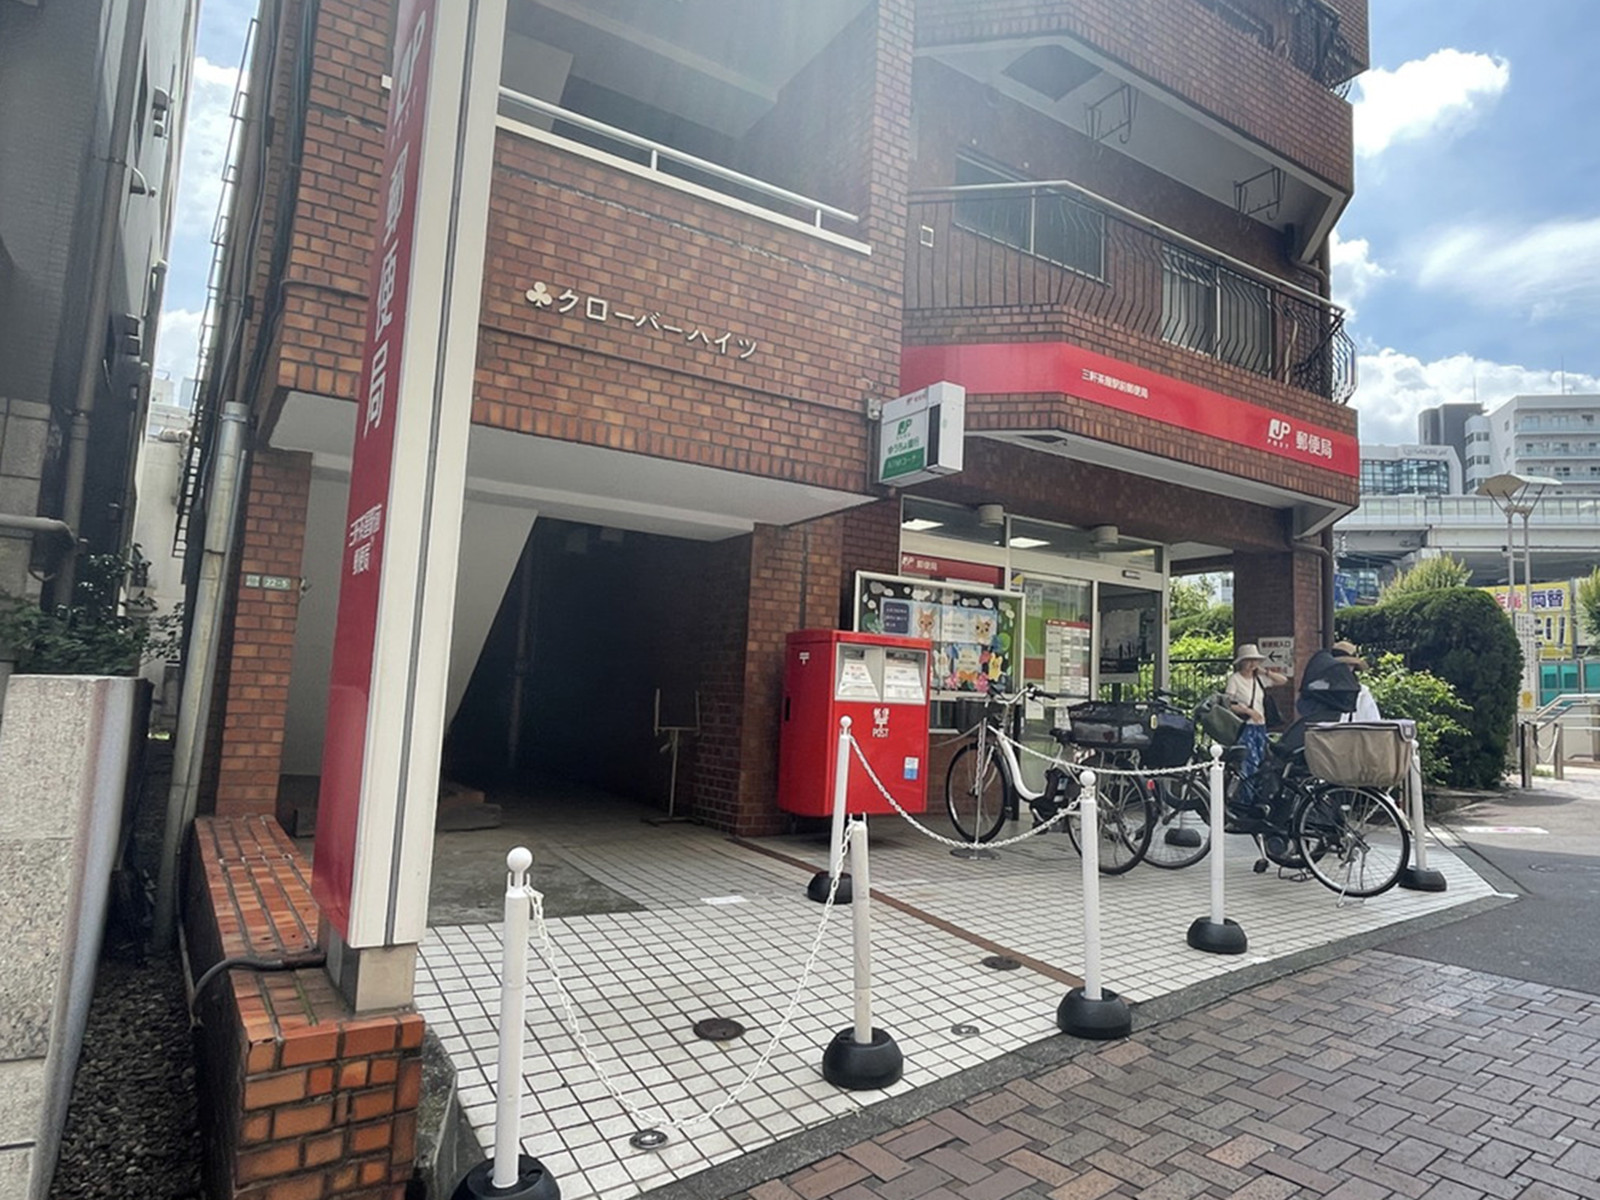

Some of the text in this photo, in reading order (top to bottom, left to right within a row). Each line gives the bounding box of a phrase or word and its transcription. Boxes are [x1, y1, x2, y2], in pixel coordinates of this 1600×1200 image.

[363, 142, 409, 439] 郵便局
[559, 289, 757, 358] クローバーハイツ
[1296, 431, 1332, 459] 郵便局
[1531, 589, 1563, 608] 両替
[872, 728, 889, 738] POST
